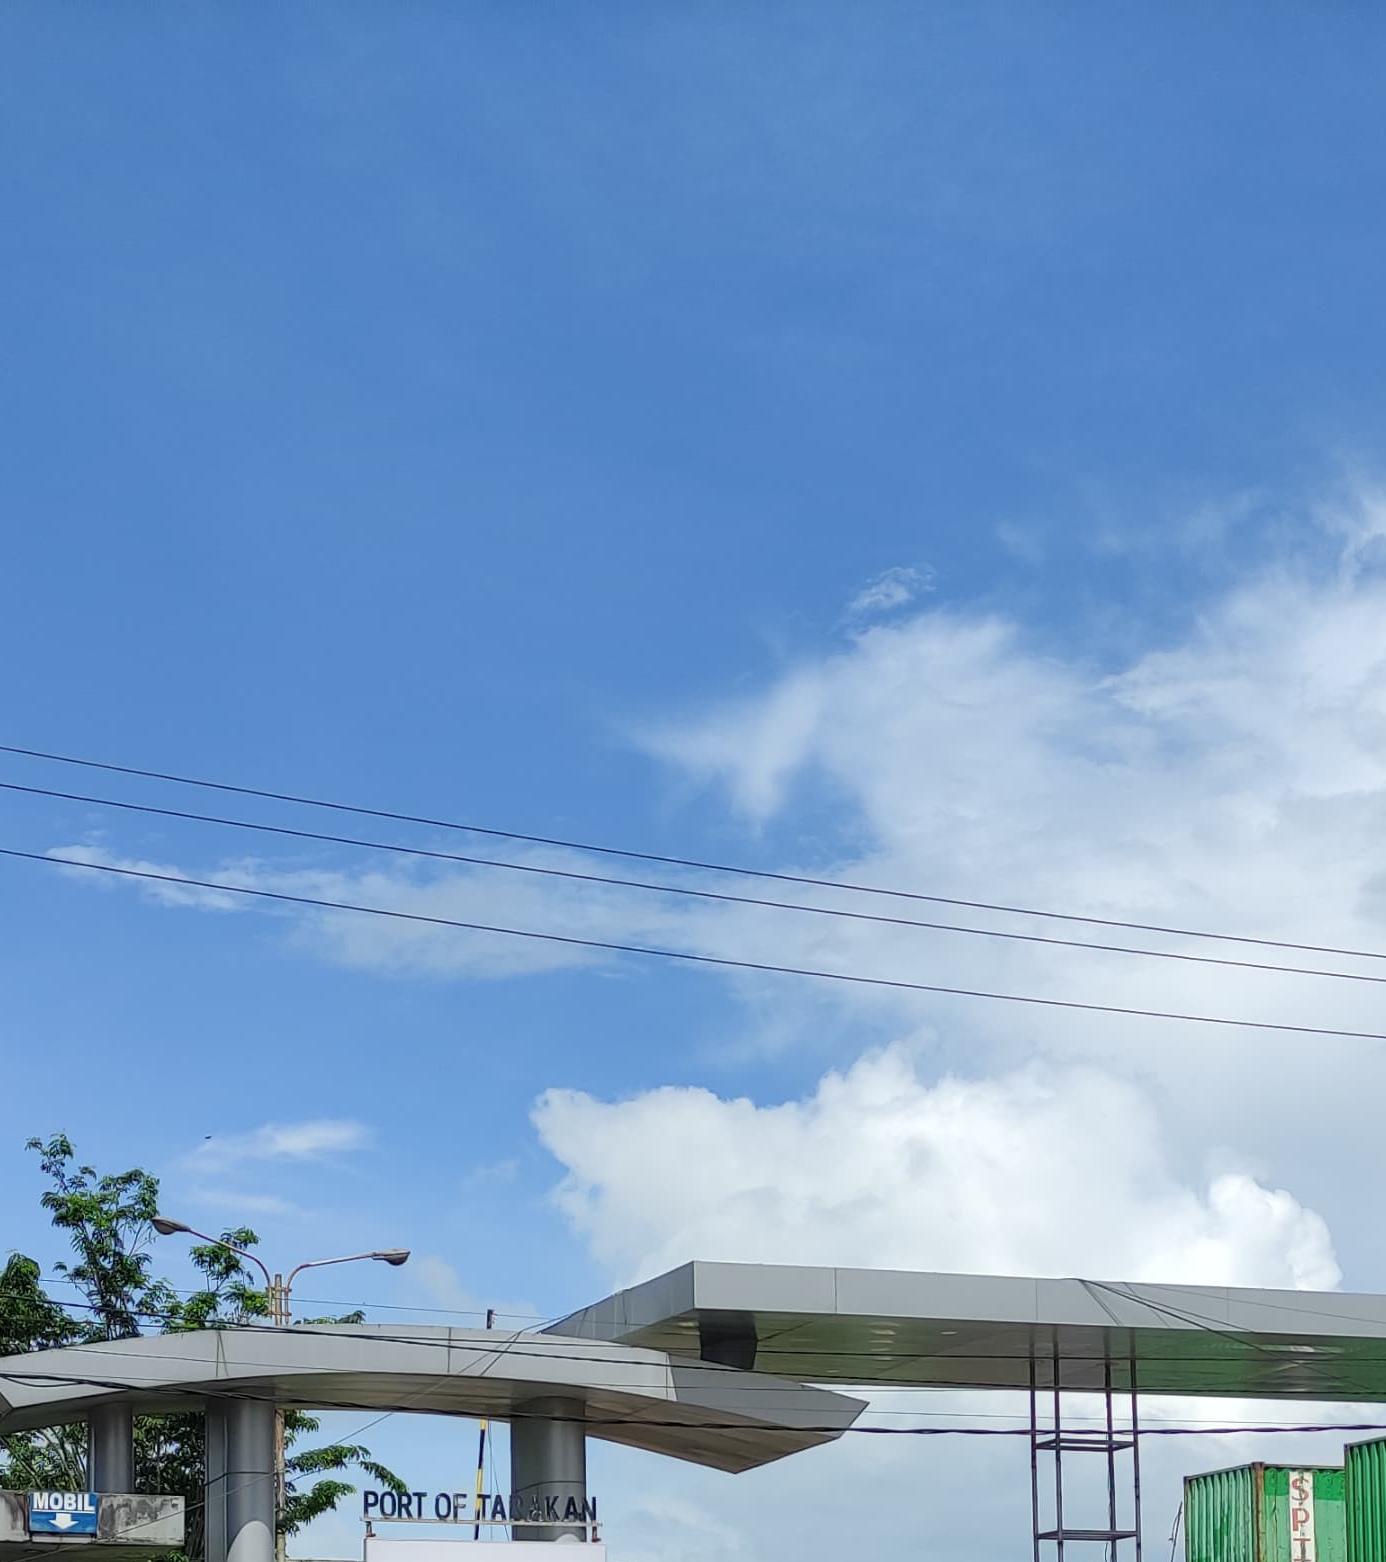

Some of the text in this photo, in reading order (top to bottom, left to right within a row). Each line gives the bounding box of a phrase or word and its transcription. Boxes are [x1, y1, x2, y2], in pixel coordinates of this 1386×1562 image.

[33, 1491, 95, 1511] MOBIL
[363, 1490, 427, 1520] PORT
[434, 1492, 468, 1522] OF
